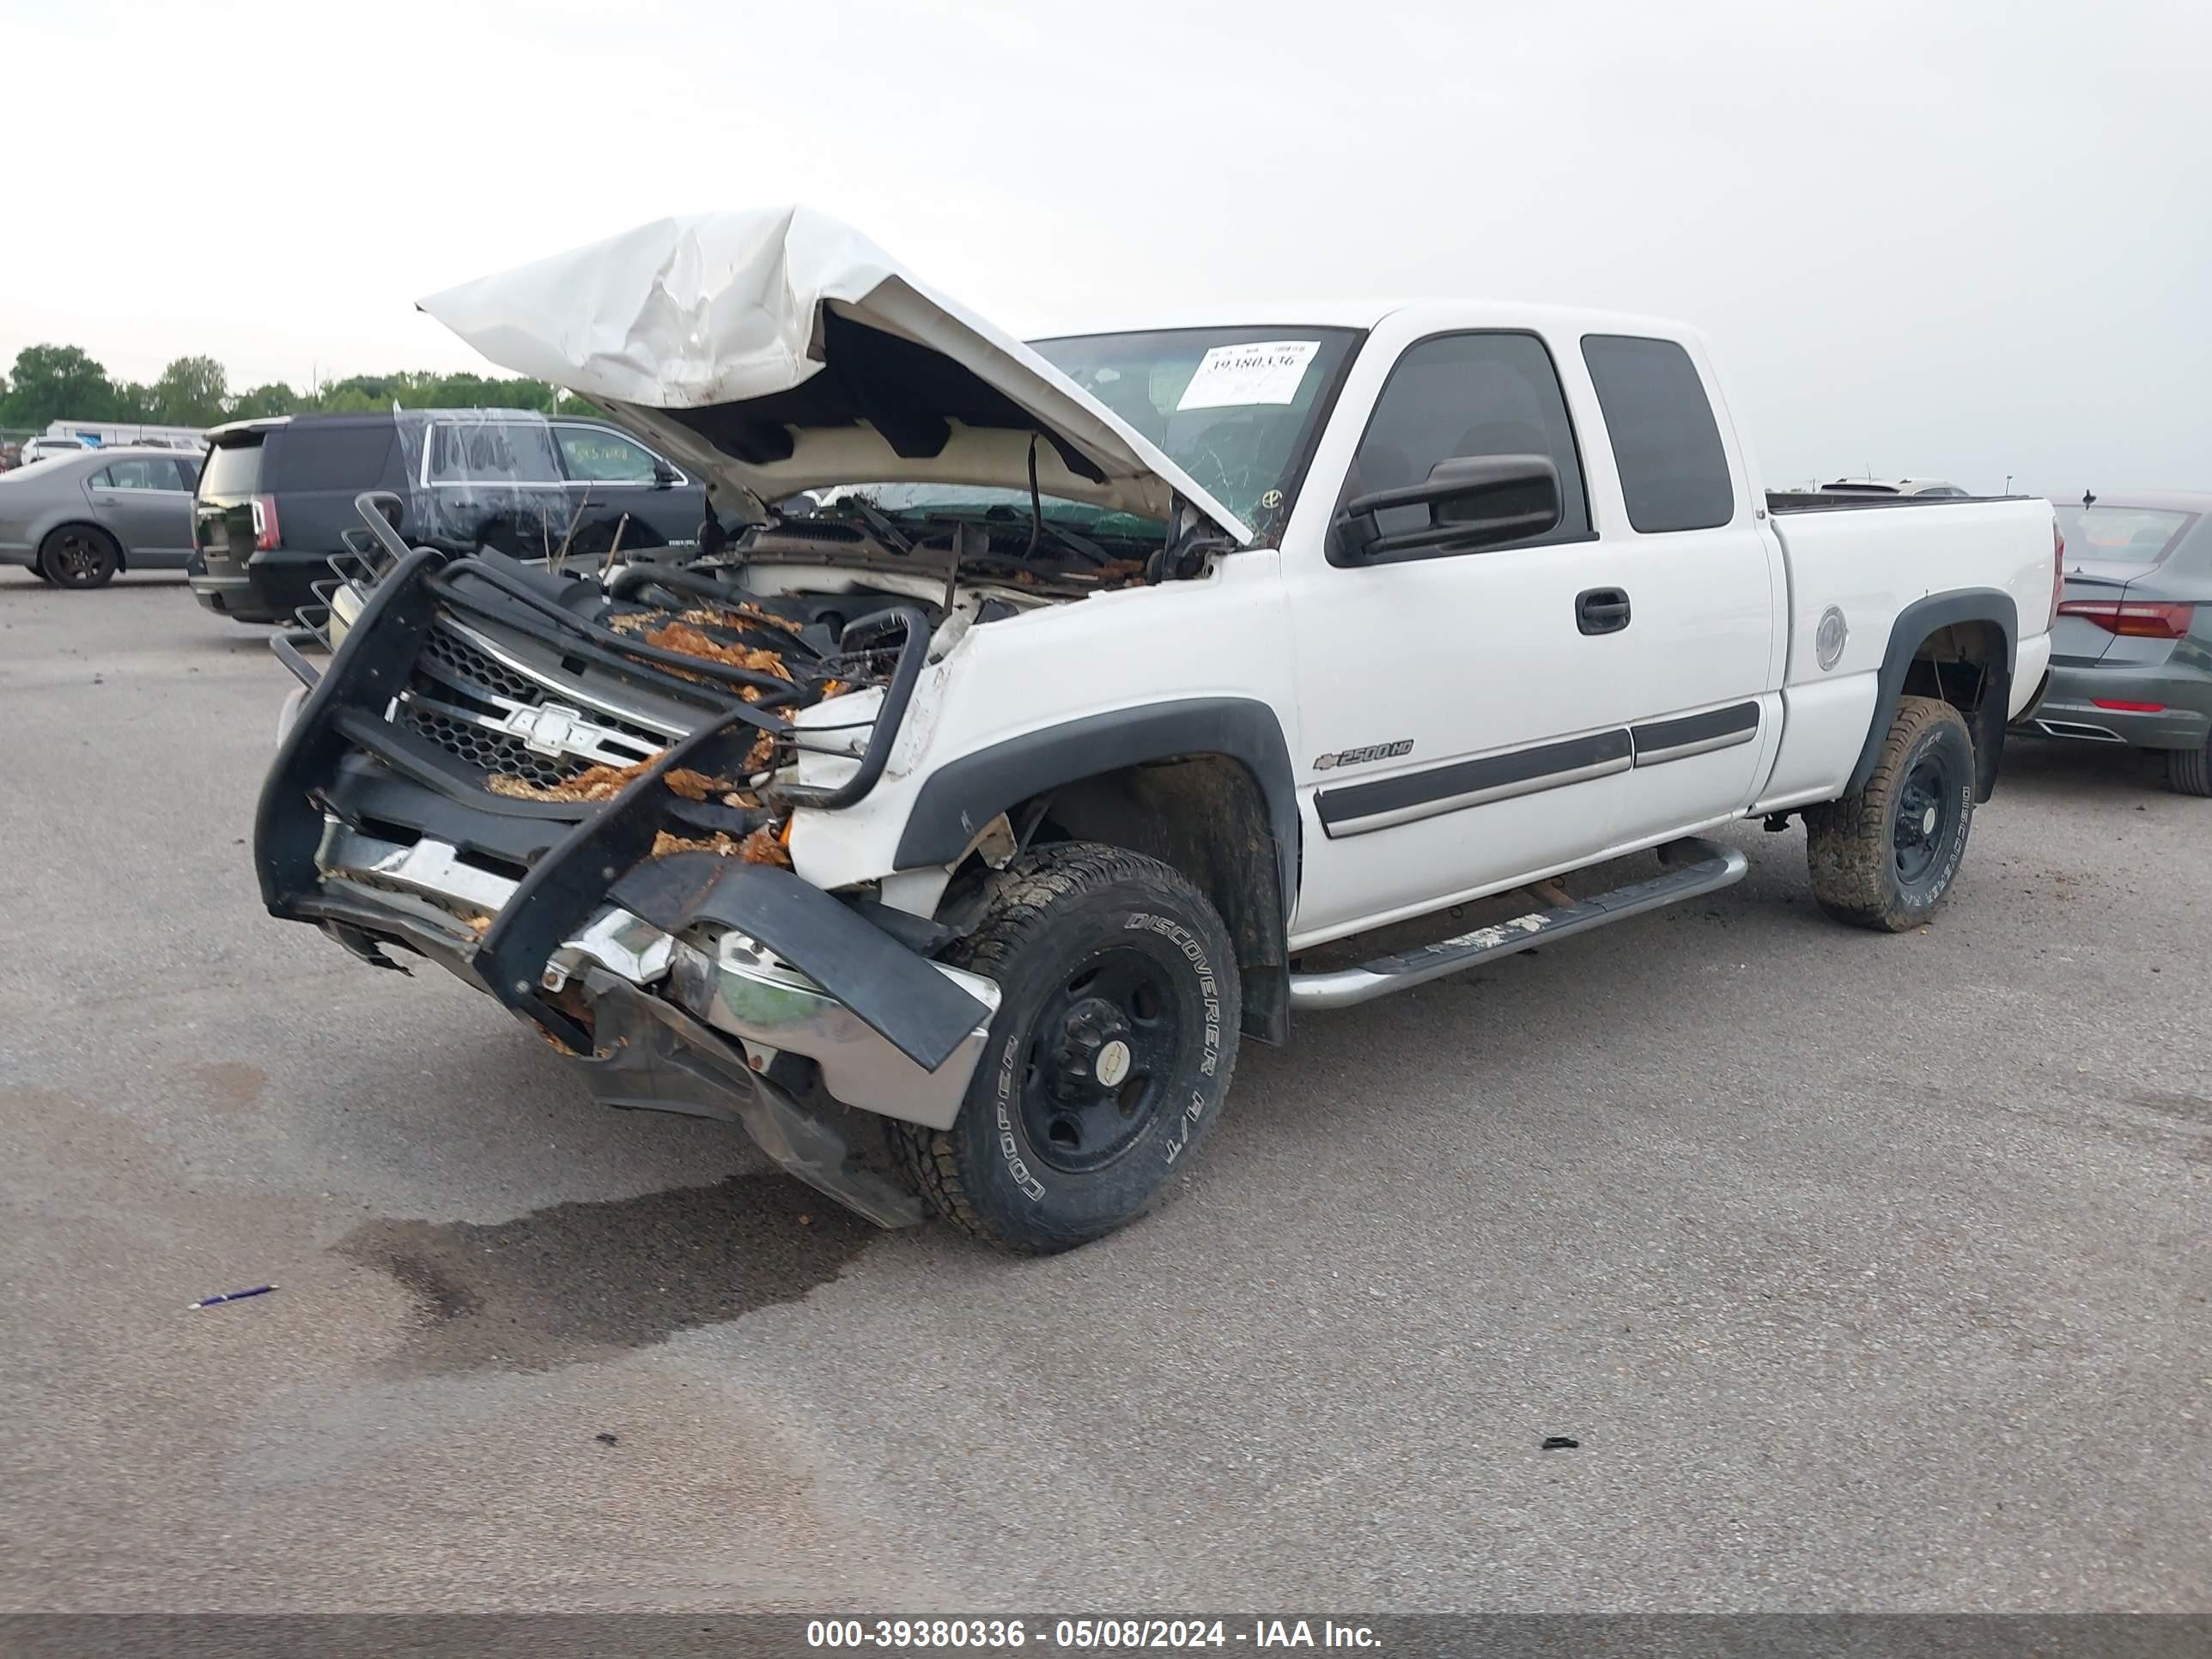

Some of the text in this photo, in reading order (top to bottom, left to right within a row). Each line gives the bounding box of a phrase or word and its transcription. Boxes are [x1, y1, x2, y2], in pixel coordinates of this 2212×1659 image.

[996, 1034, 1046, 1202] COOPER
[1123, 912, 1221, 1165] DISCOVERER A/T
